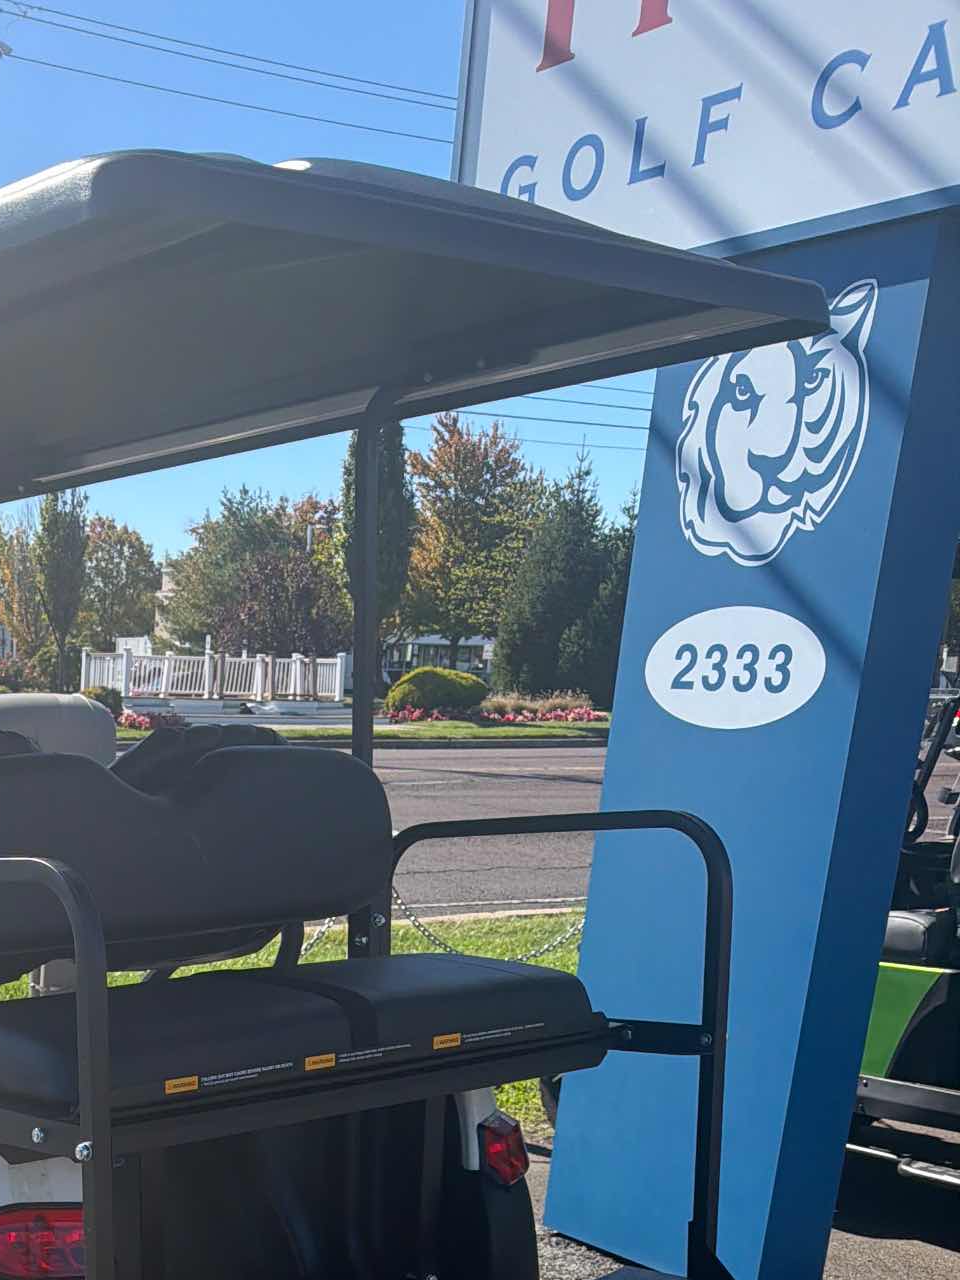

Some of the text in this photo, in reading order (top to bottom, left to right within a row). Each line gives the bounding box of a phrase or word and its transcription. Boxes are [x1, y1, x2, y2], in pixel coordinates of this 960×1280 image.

[500, 82, 743, 204] GOLF
[811, 19, 958, 131] CA
[670, 643, 793, 694] 2333
